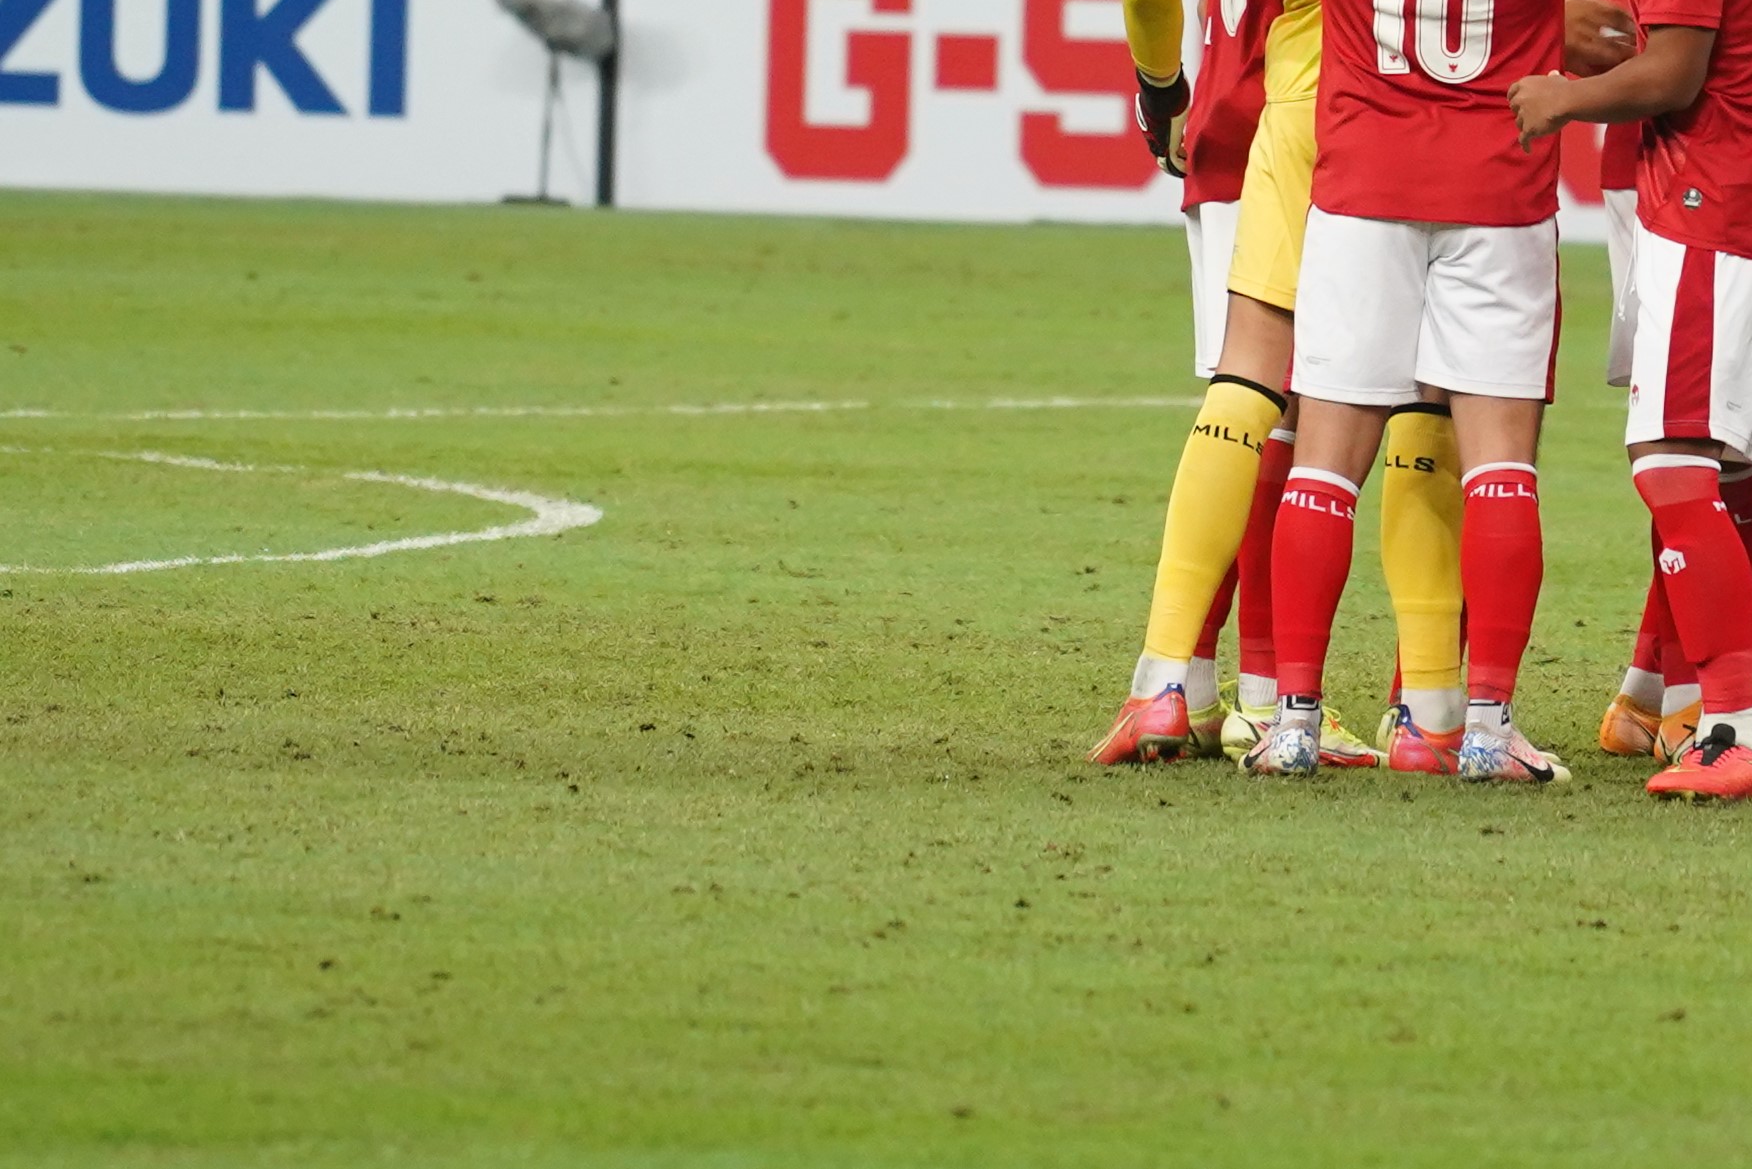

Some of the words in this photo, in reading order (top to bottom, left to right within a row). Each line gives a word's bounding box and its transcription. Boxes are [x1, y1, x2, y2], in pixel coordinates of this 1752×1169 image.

[1193, 423, 1265, 457] MILLS
[1385, 455, 1436, 474] LLS
[1281, 490, 1356, 521] MILLS
